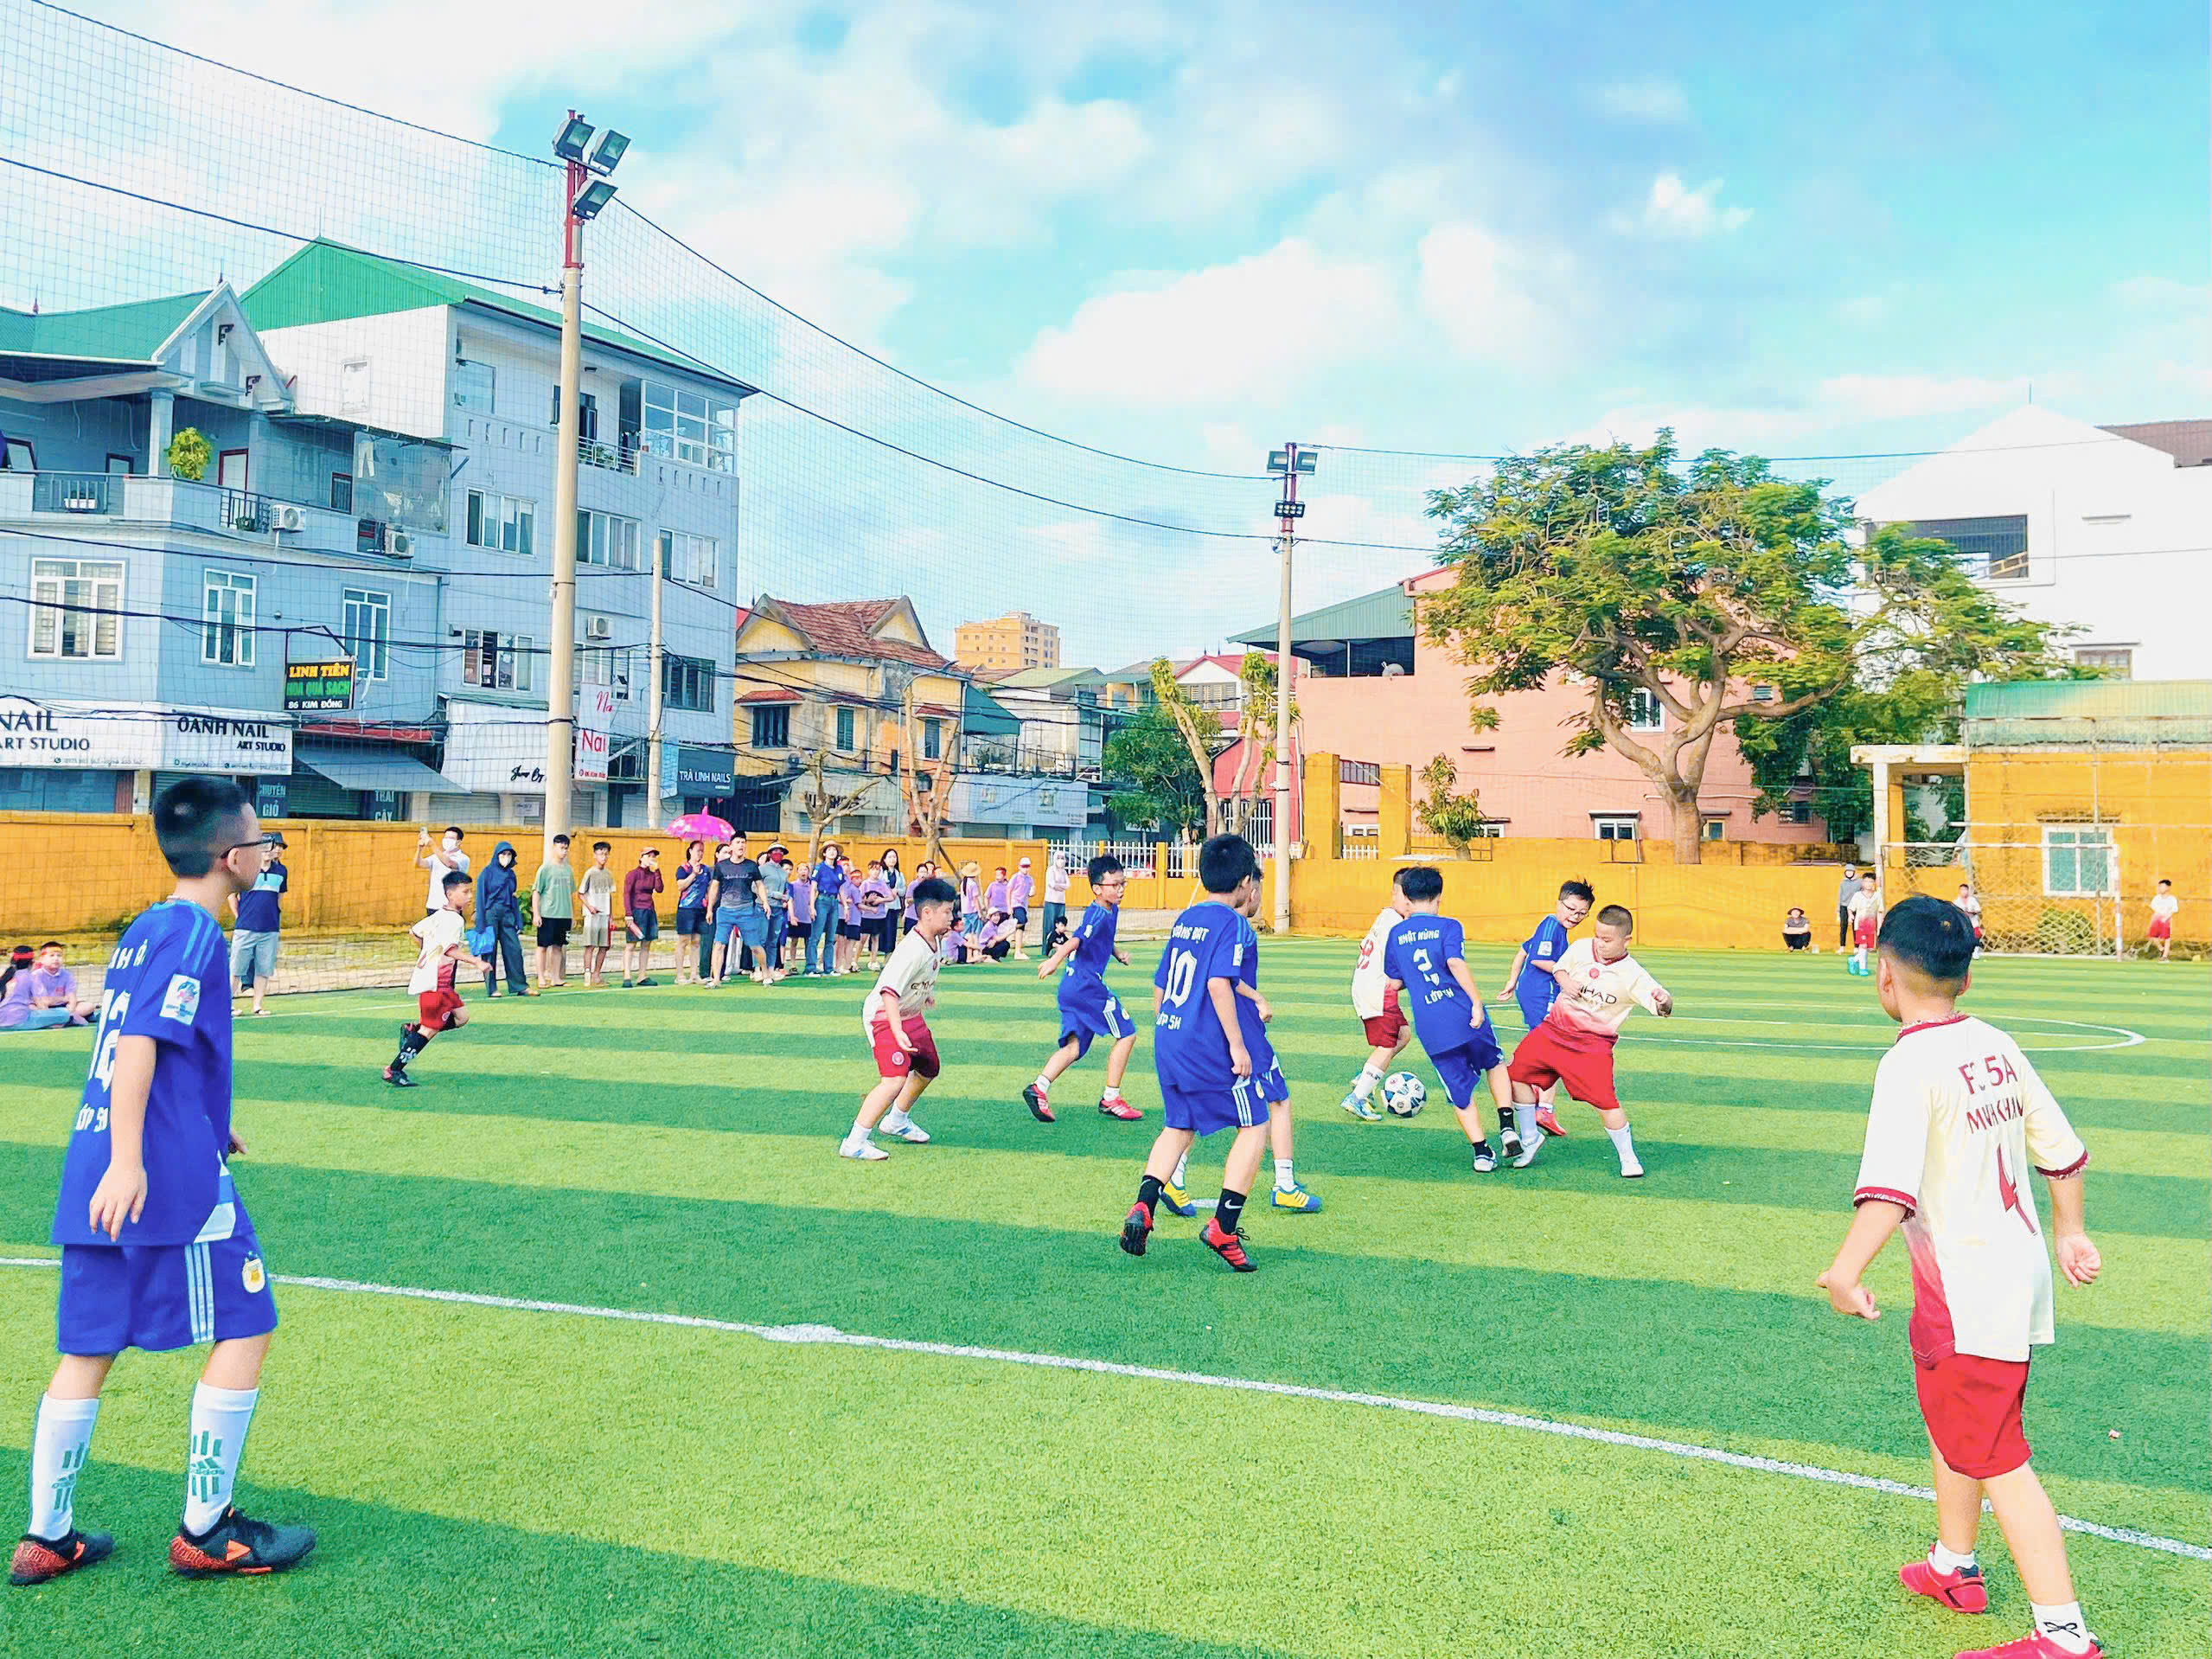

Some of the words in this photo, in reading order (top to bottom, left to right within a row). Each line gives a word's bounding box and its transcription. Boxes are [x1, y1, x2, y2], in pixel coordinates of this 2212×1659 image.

[289, 666, 318, 678] LINH
[288, 701, 299, 709] 86
[302, 700, 318, 709] KIM
[177, 716, 227, 735] OANH
[233, 721, 270, 739] NAIL
[29, 737, 90, 751] STUDIO
[237, 740, 253, 750] ART
[255, 741, 286, 753] STUDIO
[694, 771, 710, 783] LINH
[711, 772, 732, 785] NAILS
[1413, 947, 1440, 986] 2
[1162, 947, 1198, 1009] 10
[1580, 984, 1617, 1004] IHAD
